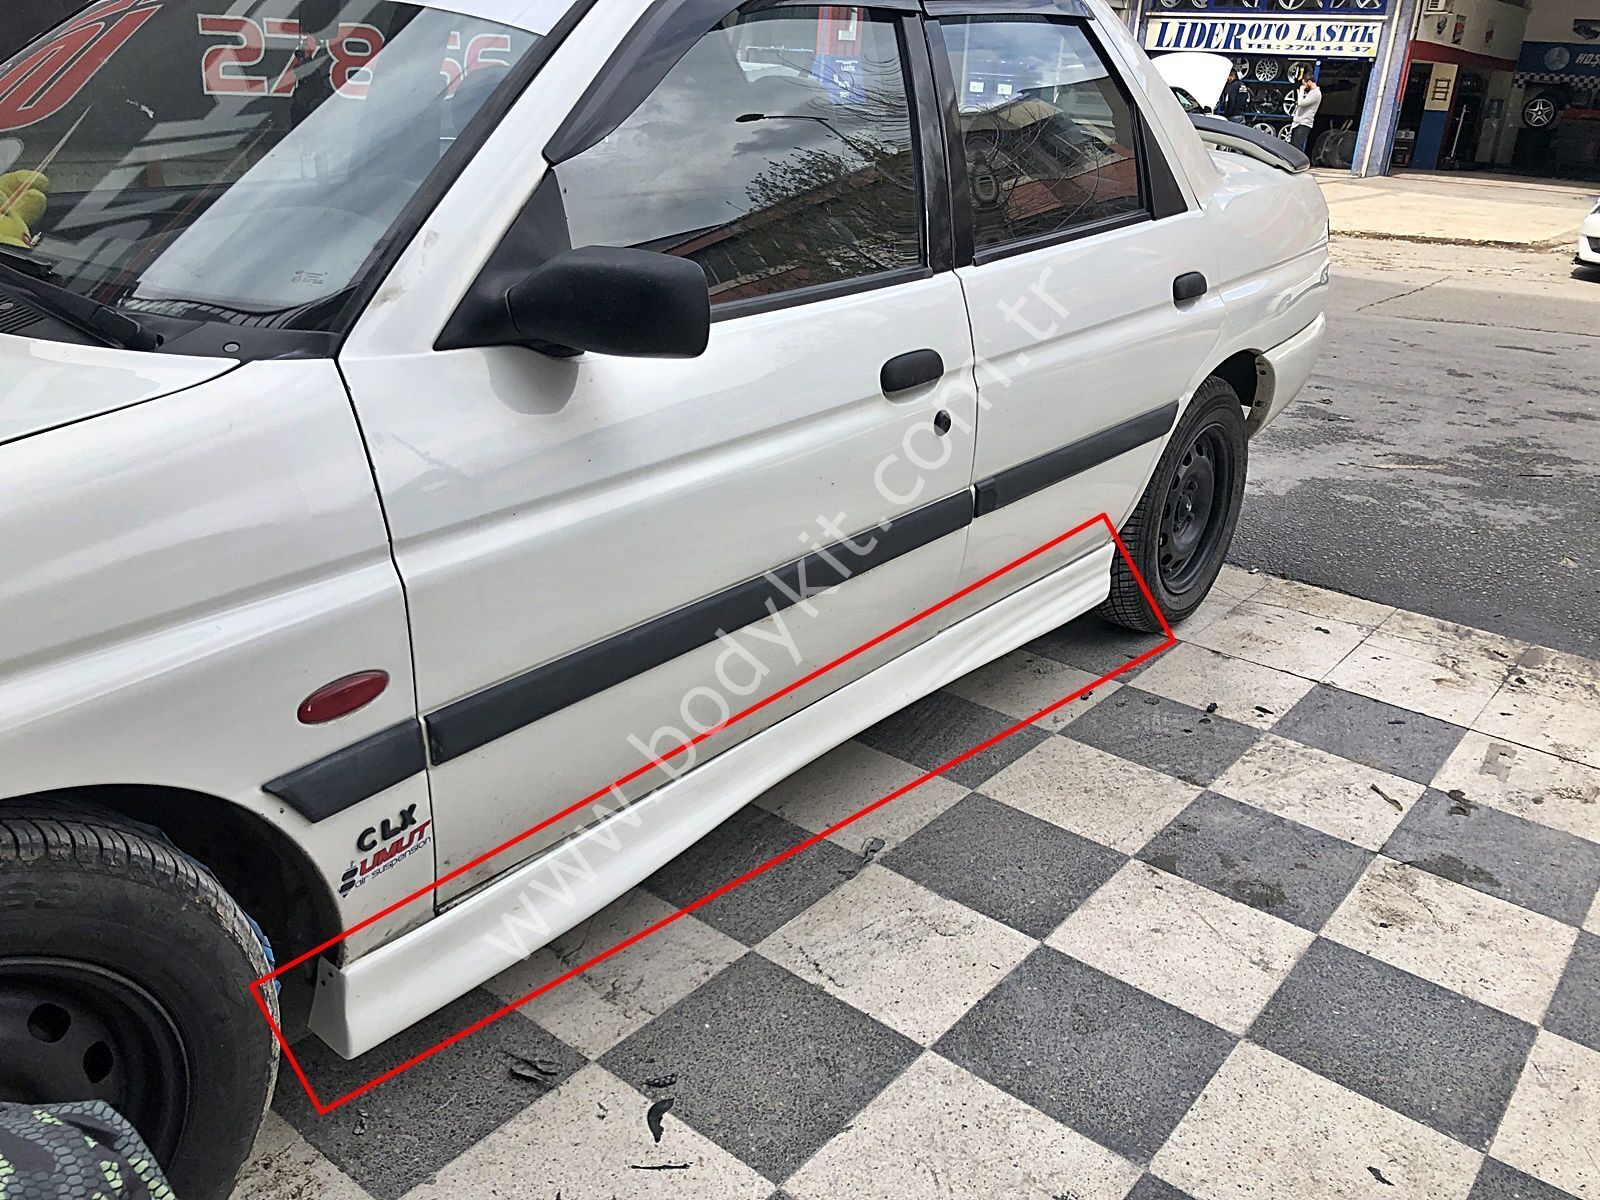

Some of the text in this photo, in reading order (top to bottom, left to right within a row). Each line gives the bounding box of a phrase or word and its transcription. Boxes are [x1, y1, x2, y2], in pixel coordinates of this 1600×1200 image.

[1248, 23, 1290, 40] OTO
[357, 803, 417, 852] CLX
[360, 819, 432, 876] UMUT
[371, 836, 431, 879] suspension
